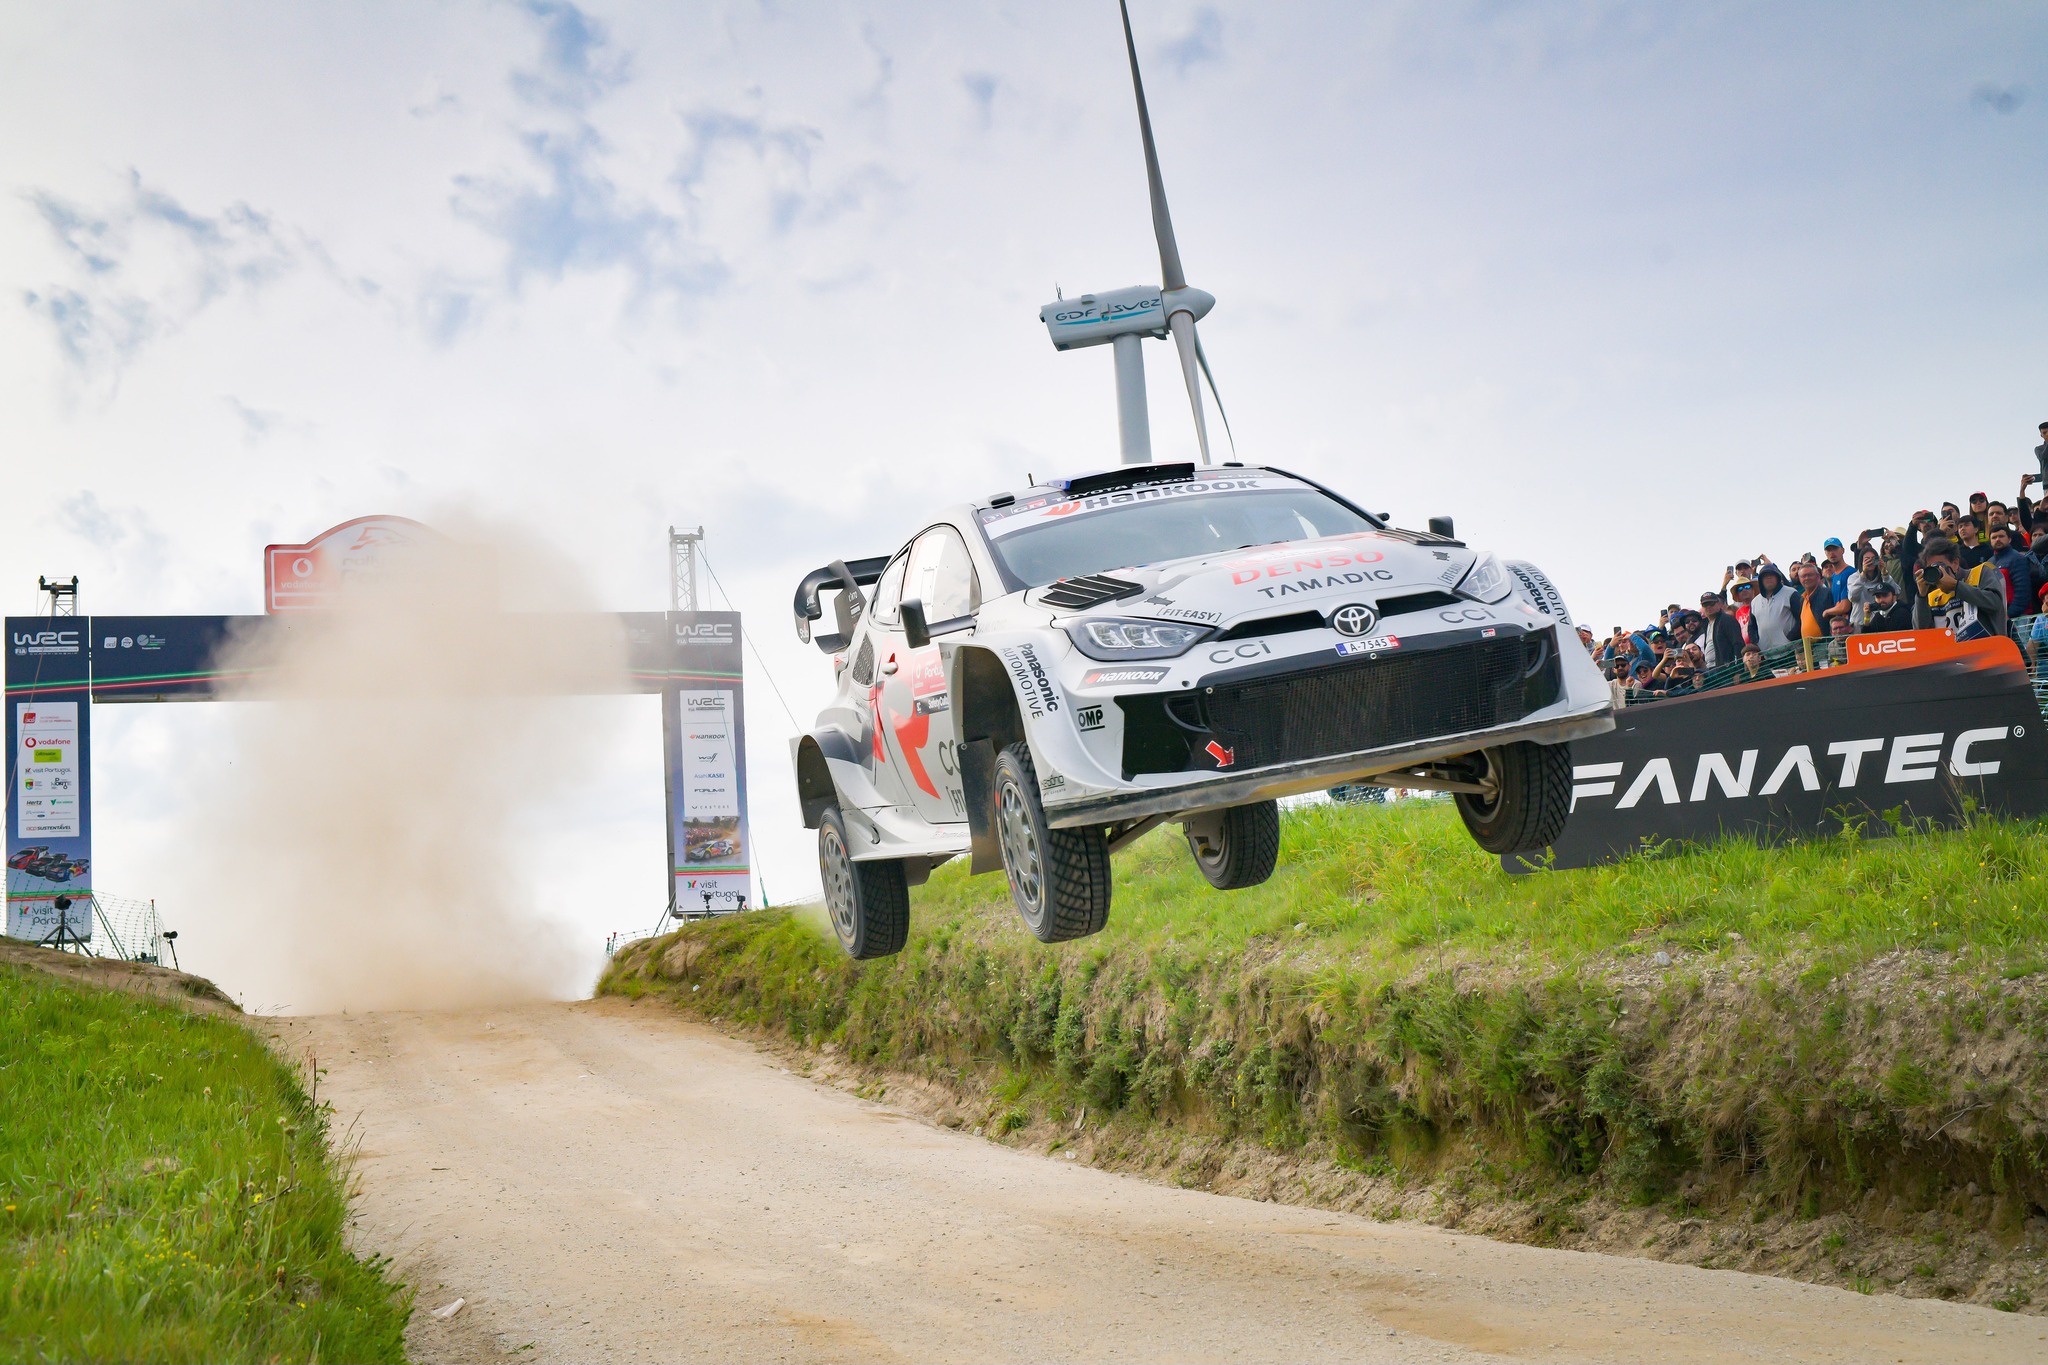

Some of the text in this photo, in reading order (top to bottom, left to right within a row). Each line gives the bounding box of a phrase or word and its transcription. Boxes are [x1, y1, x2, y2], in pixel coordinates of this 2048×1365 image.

[1055, 308, 1097, 322] GDF
[1051, 484, 1128, 502] TOYOTA
[1231, 551, 1385, 586] DENSO
[1257, 569, 1393, 599] TAMADIC
[1506, 564, 1551, 615] anasonic
[14, 631, 79, 645] WRC
[675, 623, 732, 636] WRC
[1350, 638, 1388, 652] A-7545
[1859, 637, 1917, 655] WRC
[1000, 647, 1044, 719] AUTOMOTIVE
[1017, 642, 1060, 712] Panasonic
[687, 697, 726, 706] WRC
[1078, 709, 1104, 728] OMP
[1570, 726, 2010, 814] FANATEC
[700, 879, 718, 888] visit
[700, 889, 740, 903] Portugal
[32, 906, 54, 915] visit
